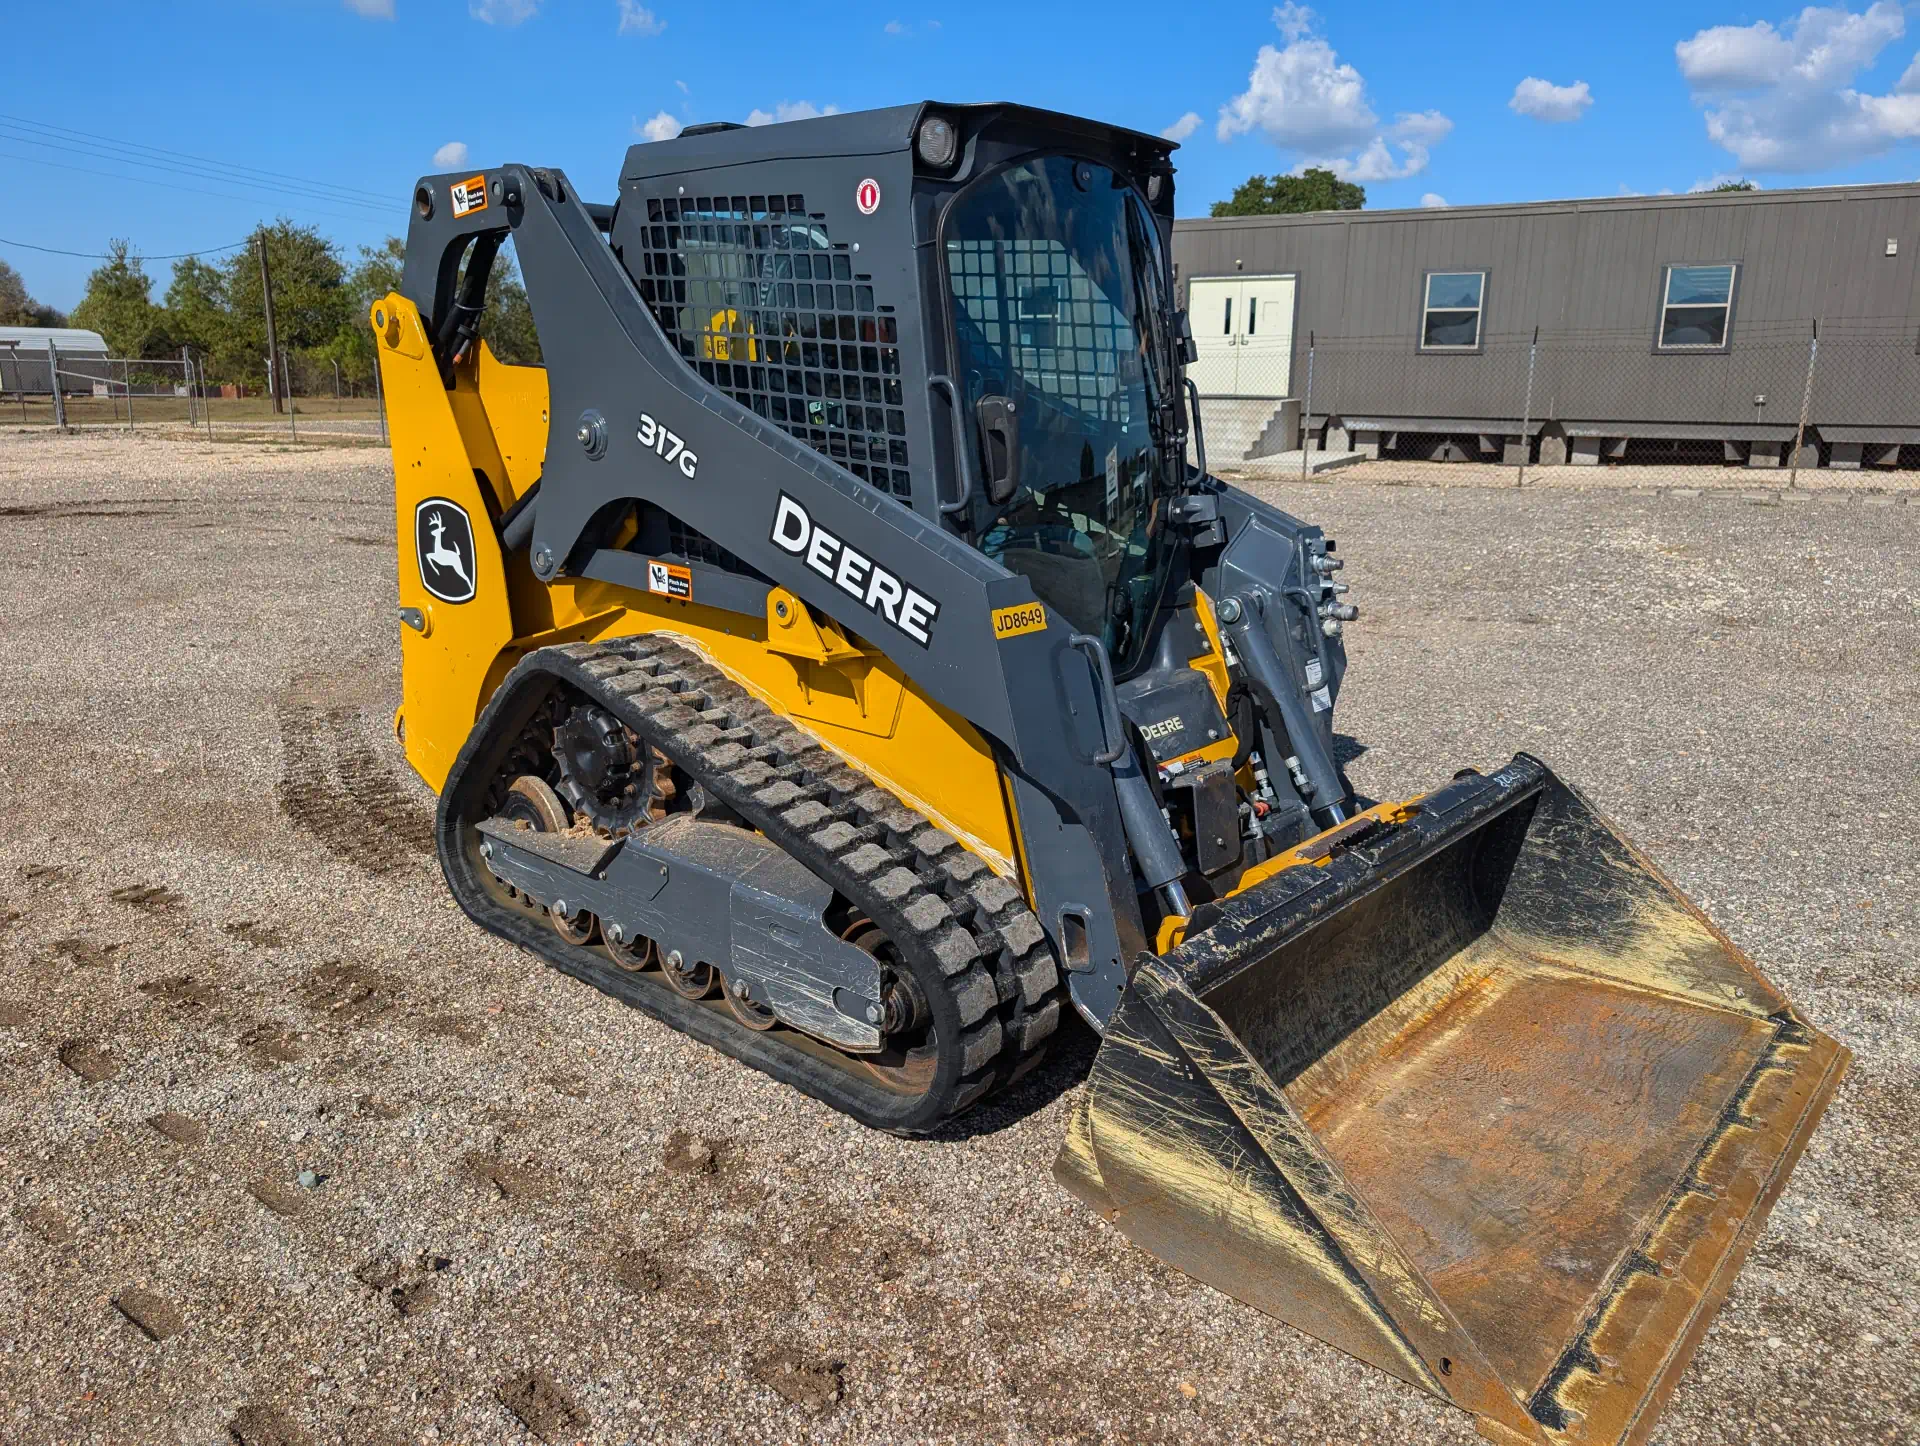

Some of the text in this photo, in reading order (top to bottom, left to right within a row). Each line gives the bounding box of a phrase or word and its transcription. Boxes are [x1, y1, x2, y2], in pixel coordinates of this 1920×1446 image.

[637, 412, 699, 479] 317G
[771, 494, 938, 645] DEERE
[996, 608, 1043, 632] JD8649
[1138, 716, 1185, 742] DEERE
